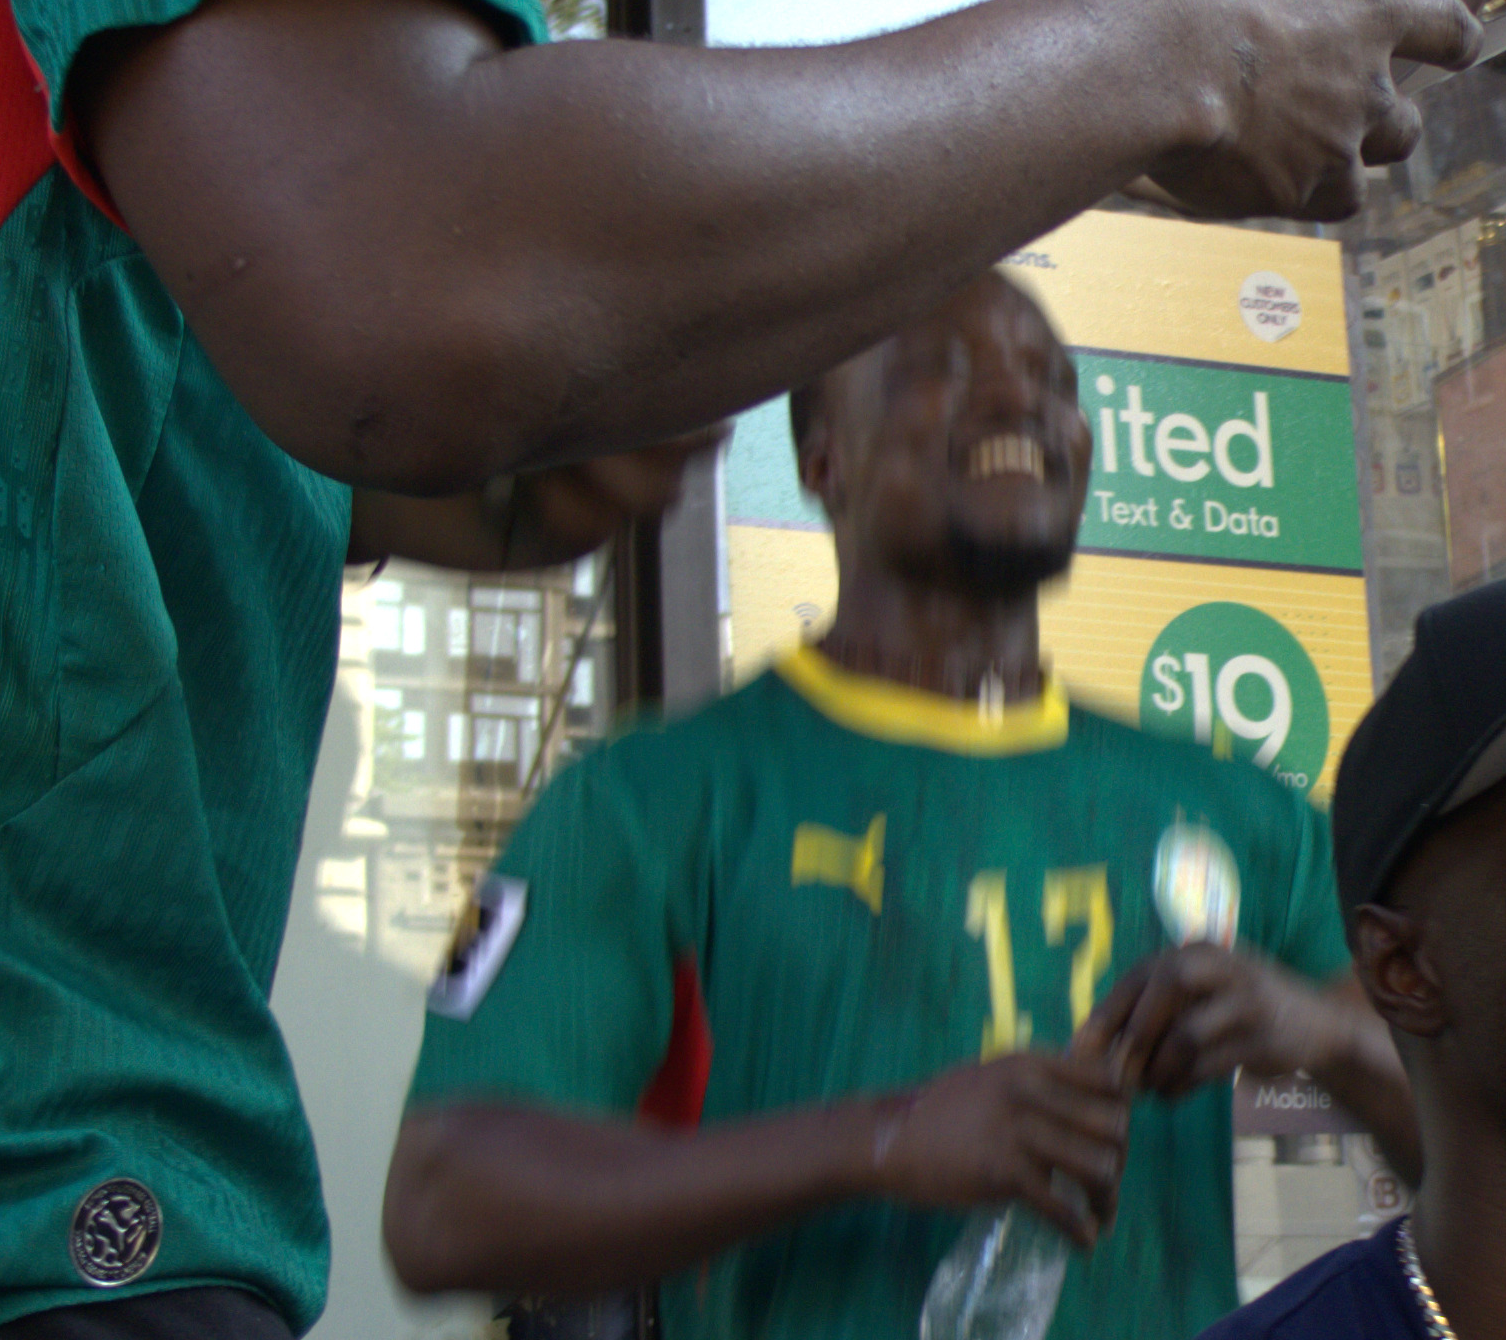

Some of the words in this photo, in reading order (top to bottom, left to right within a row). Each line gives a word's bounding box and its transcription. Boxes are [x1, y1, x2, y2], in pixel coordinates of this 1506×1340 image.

[1255, 285, 1287, 298] NEW
[1240, 297, 1301, 314] CUSTOMERS
[1256, 312, 1288, 326] ONLY
[1096, 374, 1275, 490] ited
[1094, 490, 1159, 529] Text
[1169, 498, 1194, 531] &
[1204, 501, 1281, 539] Data
[1151, 649, 1293, 769] $19
[1255, 1085, 1332, 1110] Mobile
